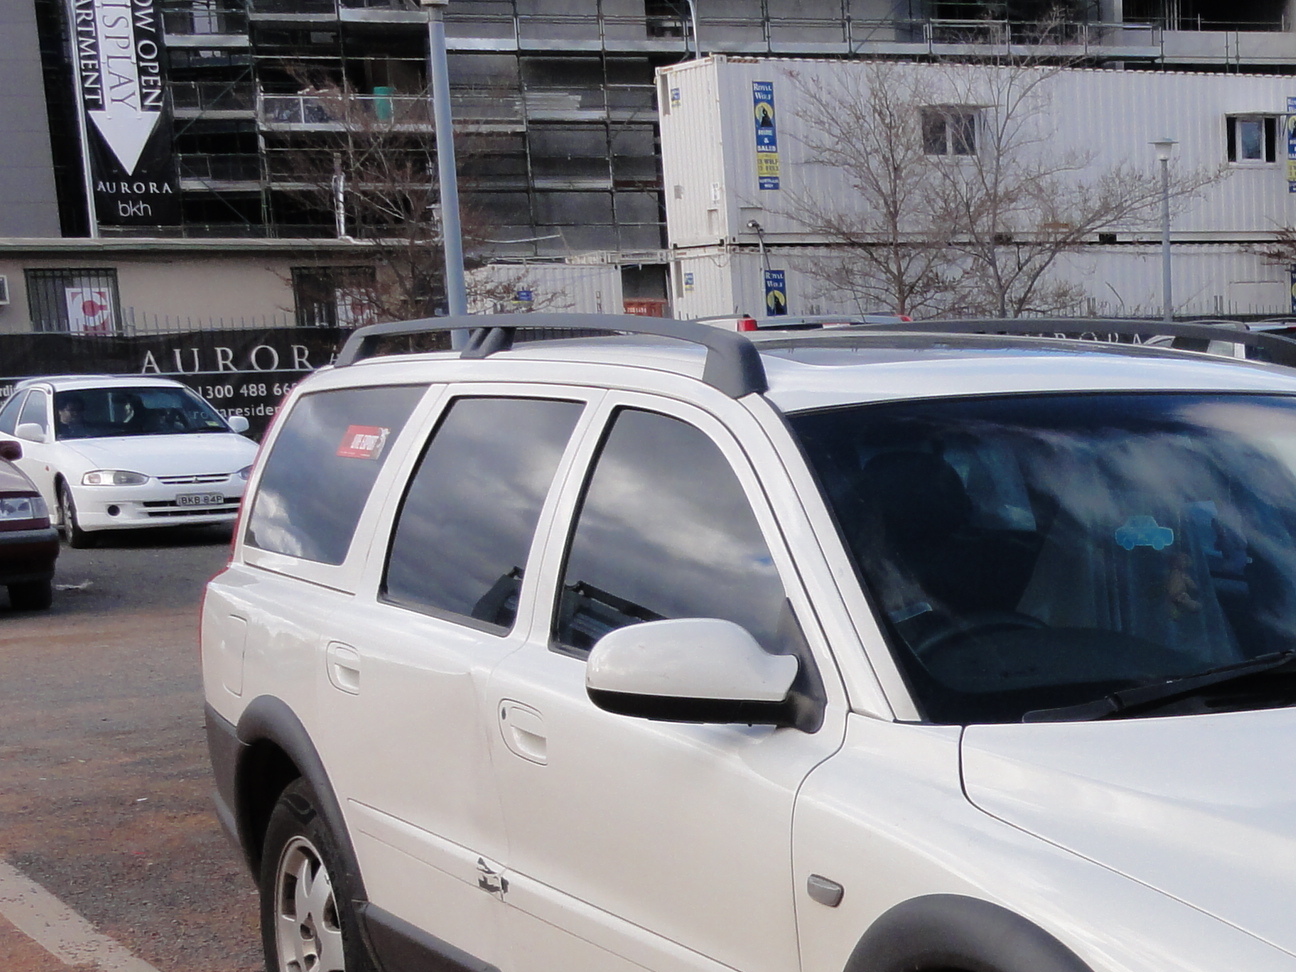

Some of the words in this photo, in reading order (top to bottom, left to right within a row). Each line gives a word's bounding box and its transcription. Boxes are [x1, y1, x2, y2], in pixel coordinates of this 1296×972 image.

[137, 40, 163, 107] OPEN
[97, 181, 172, 194] AURORA
[118, 200, 152, 217] bkh
[239, 383, 267, 398] 488
